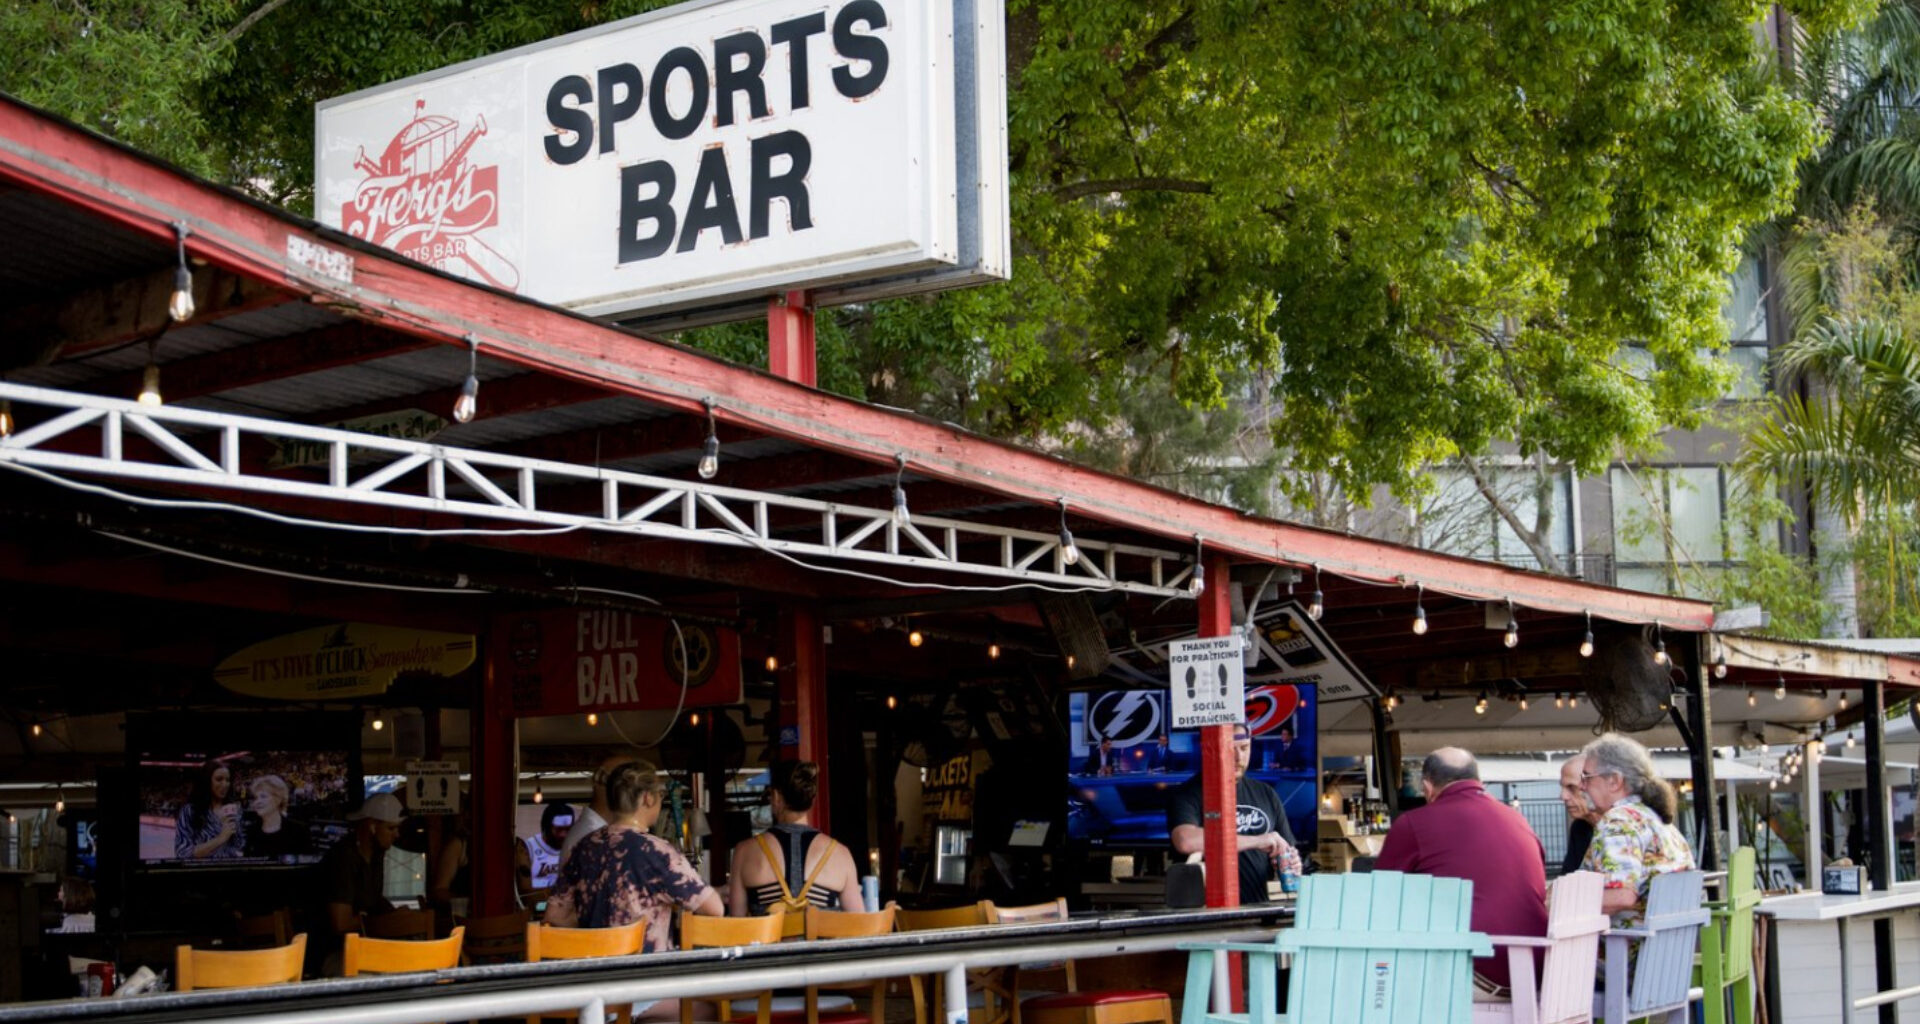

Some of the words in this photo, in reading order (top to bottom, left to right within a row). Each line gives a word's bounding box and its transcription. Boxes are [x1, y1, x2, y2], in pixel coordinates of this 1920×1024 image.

[544, 0, 890, 166] SPORTS
[347, 157, 496, 245] Ferg's
[617, 130, 814, 264] BAR
[433, 240, 467, 257] BAR
[577, 610, 639, 652] FULL
[1181, 642, 1211, 652] THANK
[1214, 640, 1231, 649] YOU
[252, 658, 281, 682] IT'S
[283, 653, 313, 679] FIVE
[315, 646, 367, 674] O'CLOCK
[1171, 654, 1189, 663] FOR
[1192, 650, 1239, 662] PRACTICING
[577, 652, 641, 707] BAR
[1192, 700, 1227, 712] SOCIAL
